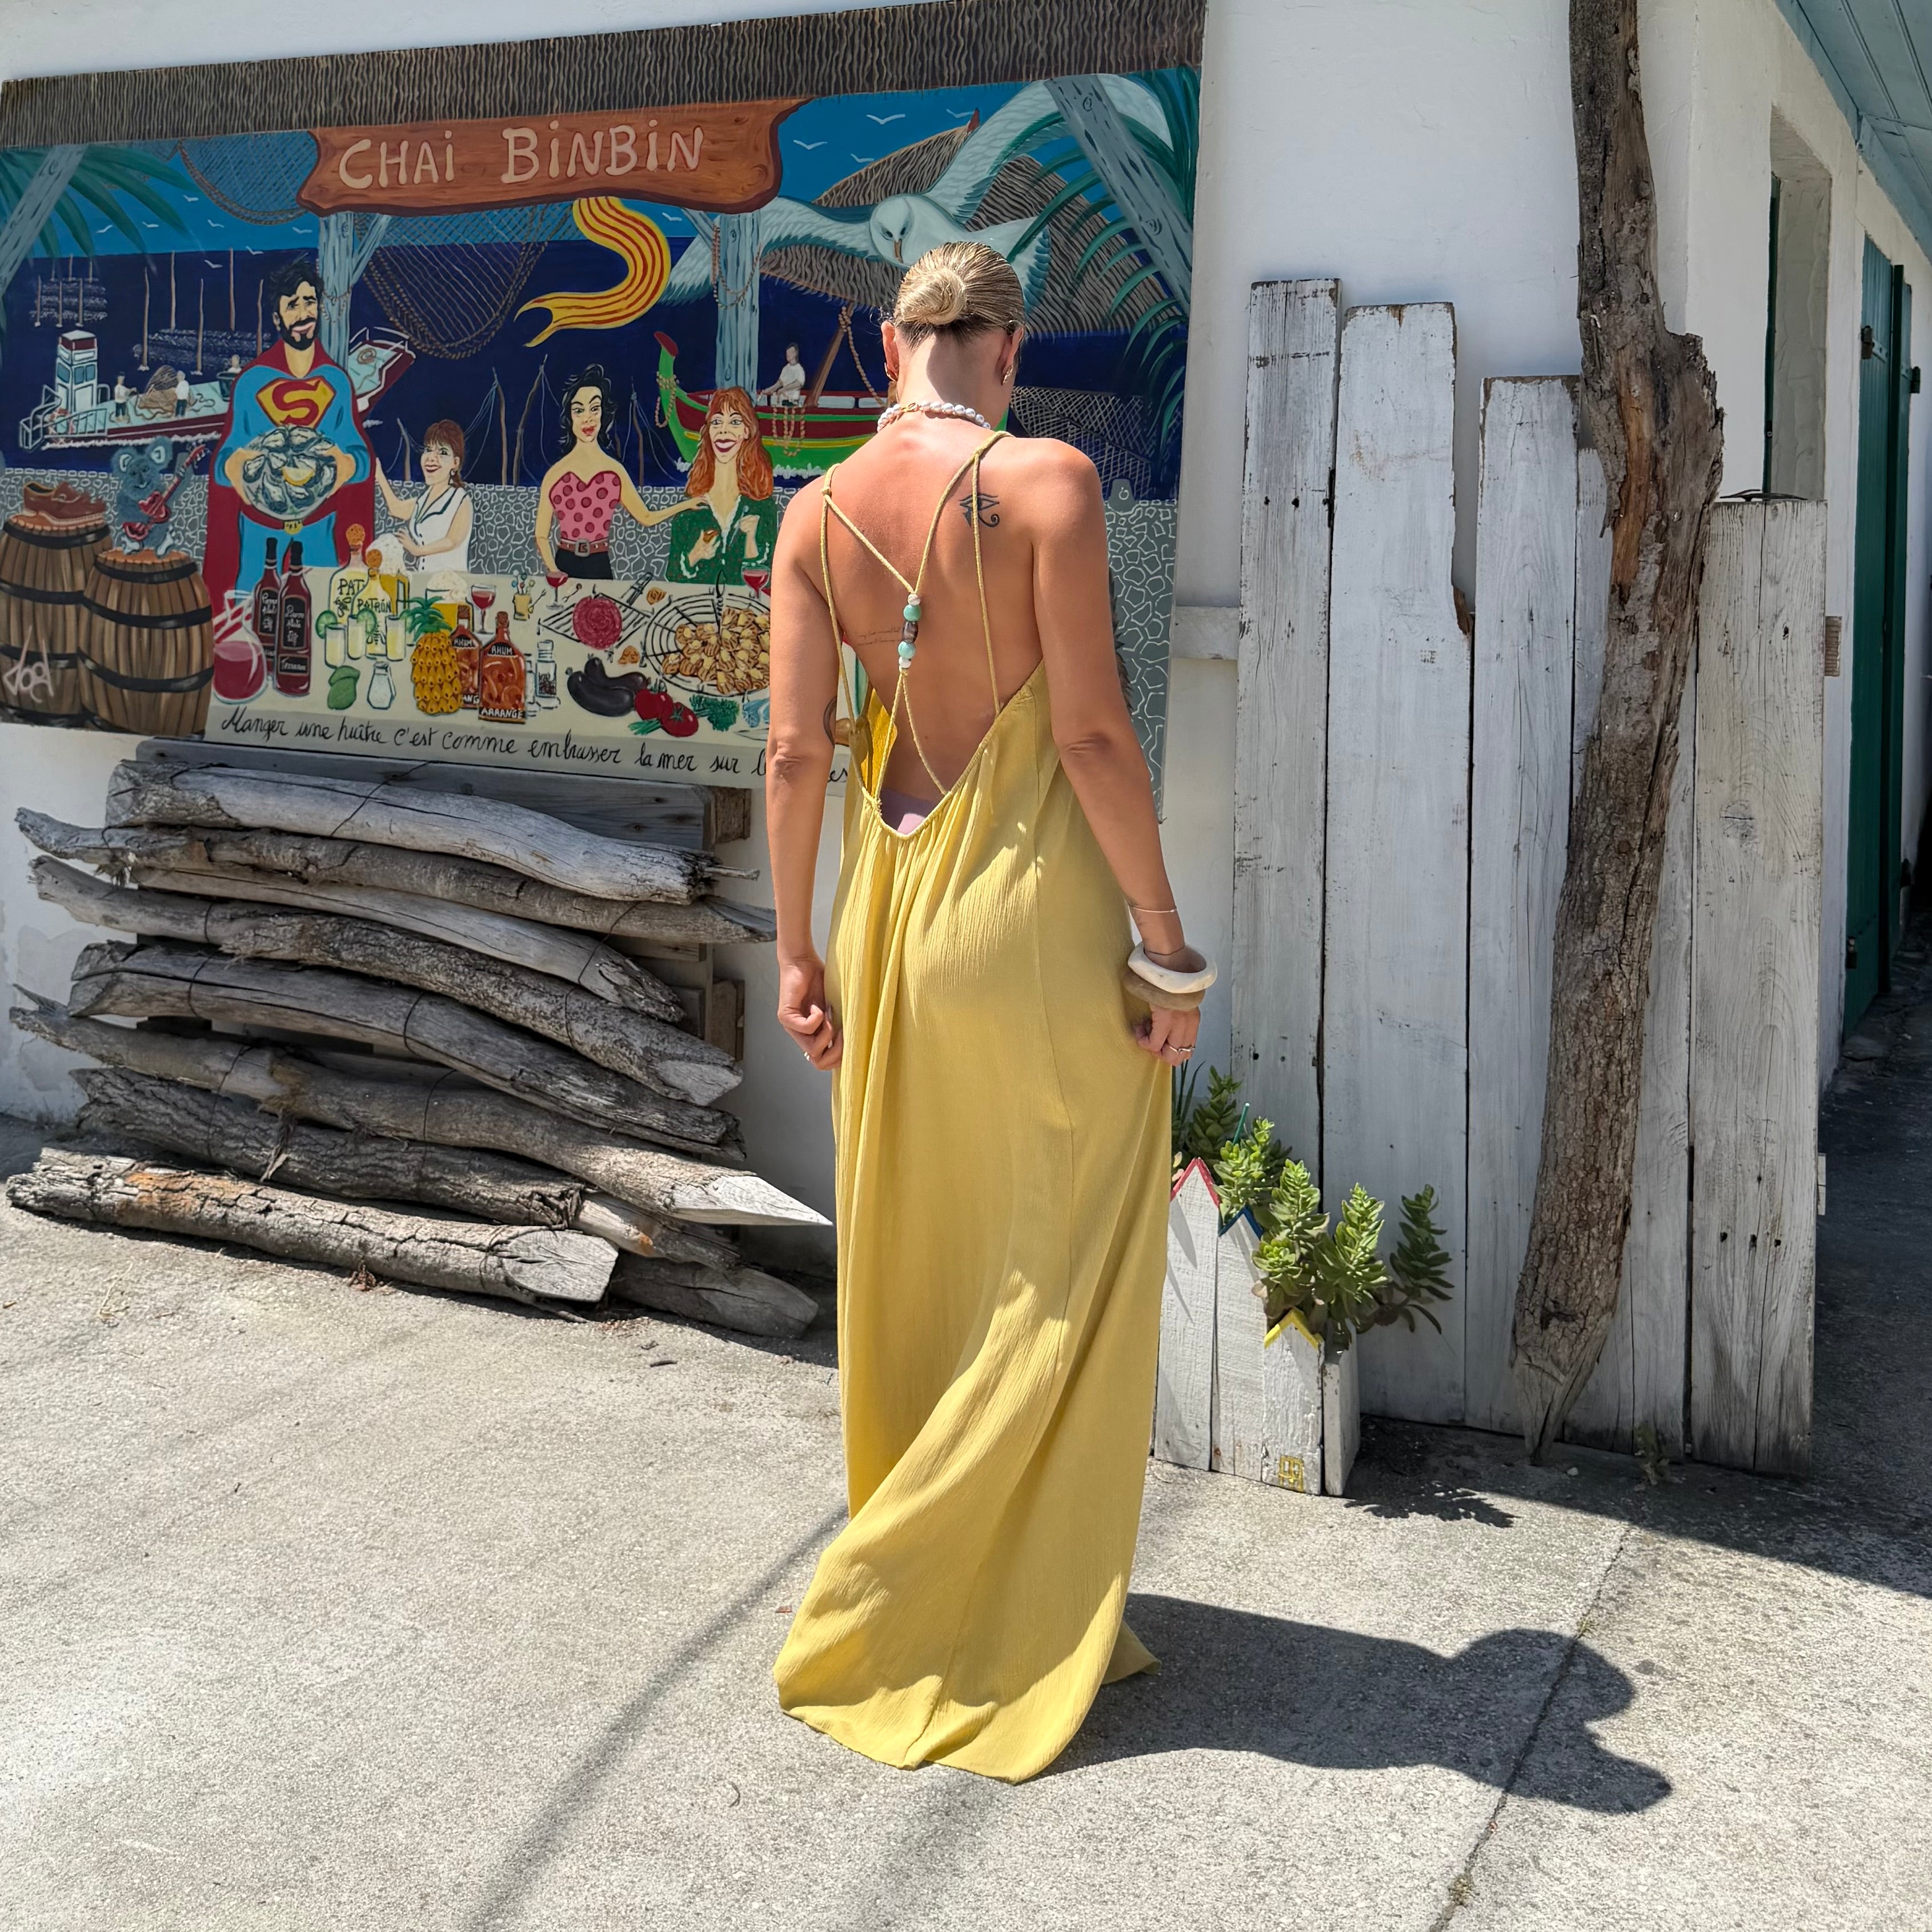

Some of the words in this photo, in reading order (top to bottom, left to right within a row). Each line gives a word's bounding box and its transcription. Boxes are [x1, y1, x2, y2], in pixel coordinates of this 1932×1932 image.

[337, 578, 365, 595] PAT
[491, 646, 513, 655] RHUM
[222, 706, 288, 741] Manger
[295, 721, 334, 738] une
[527, 728, 622, 764] embrasser
[634, 741, 654, 767] la
[656, 751, 698, 771] mer
[710, 755, 741, 774] sur
